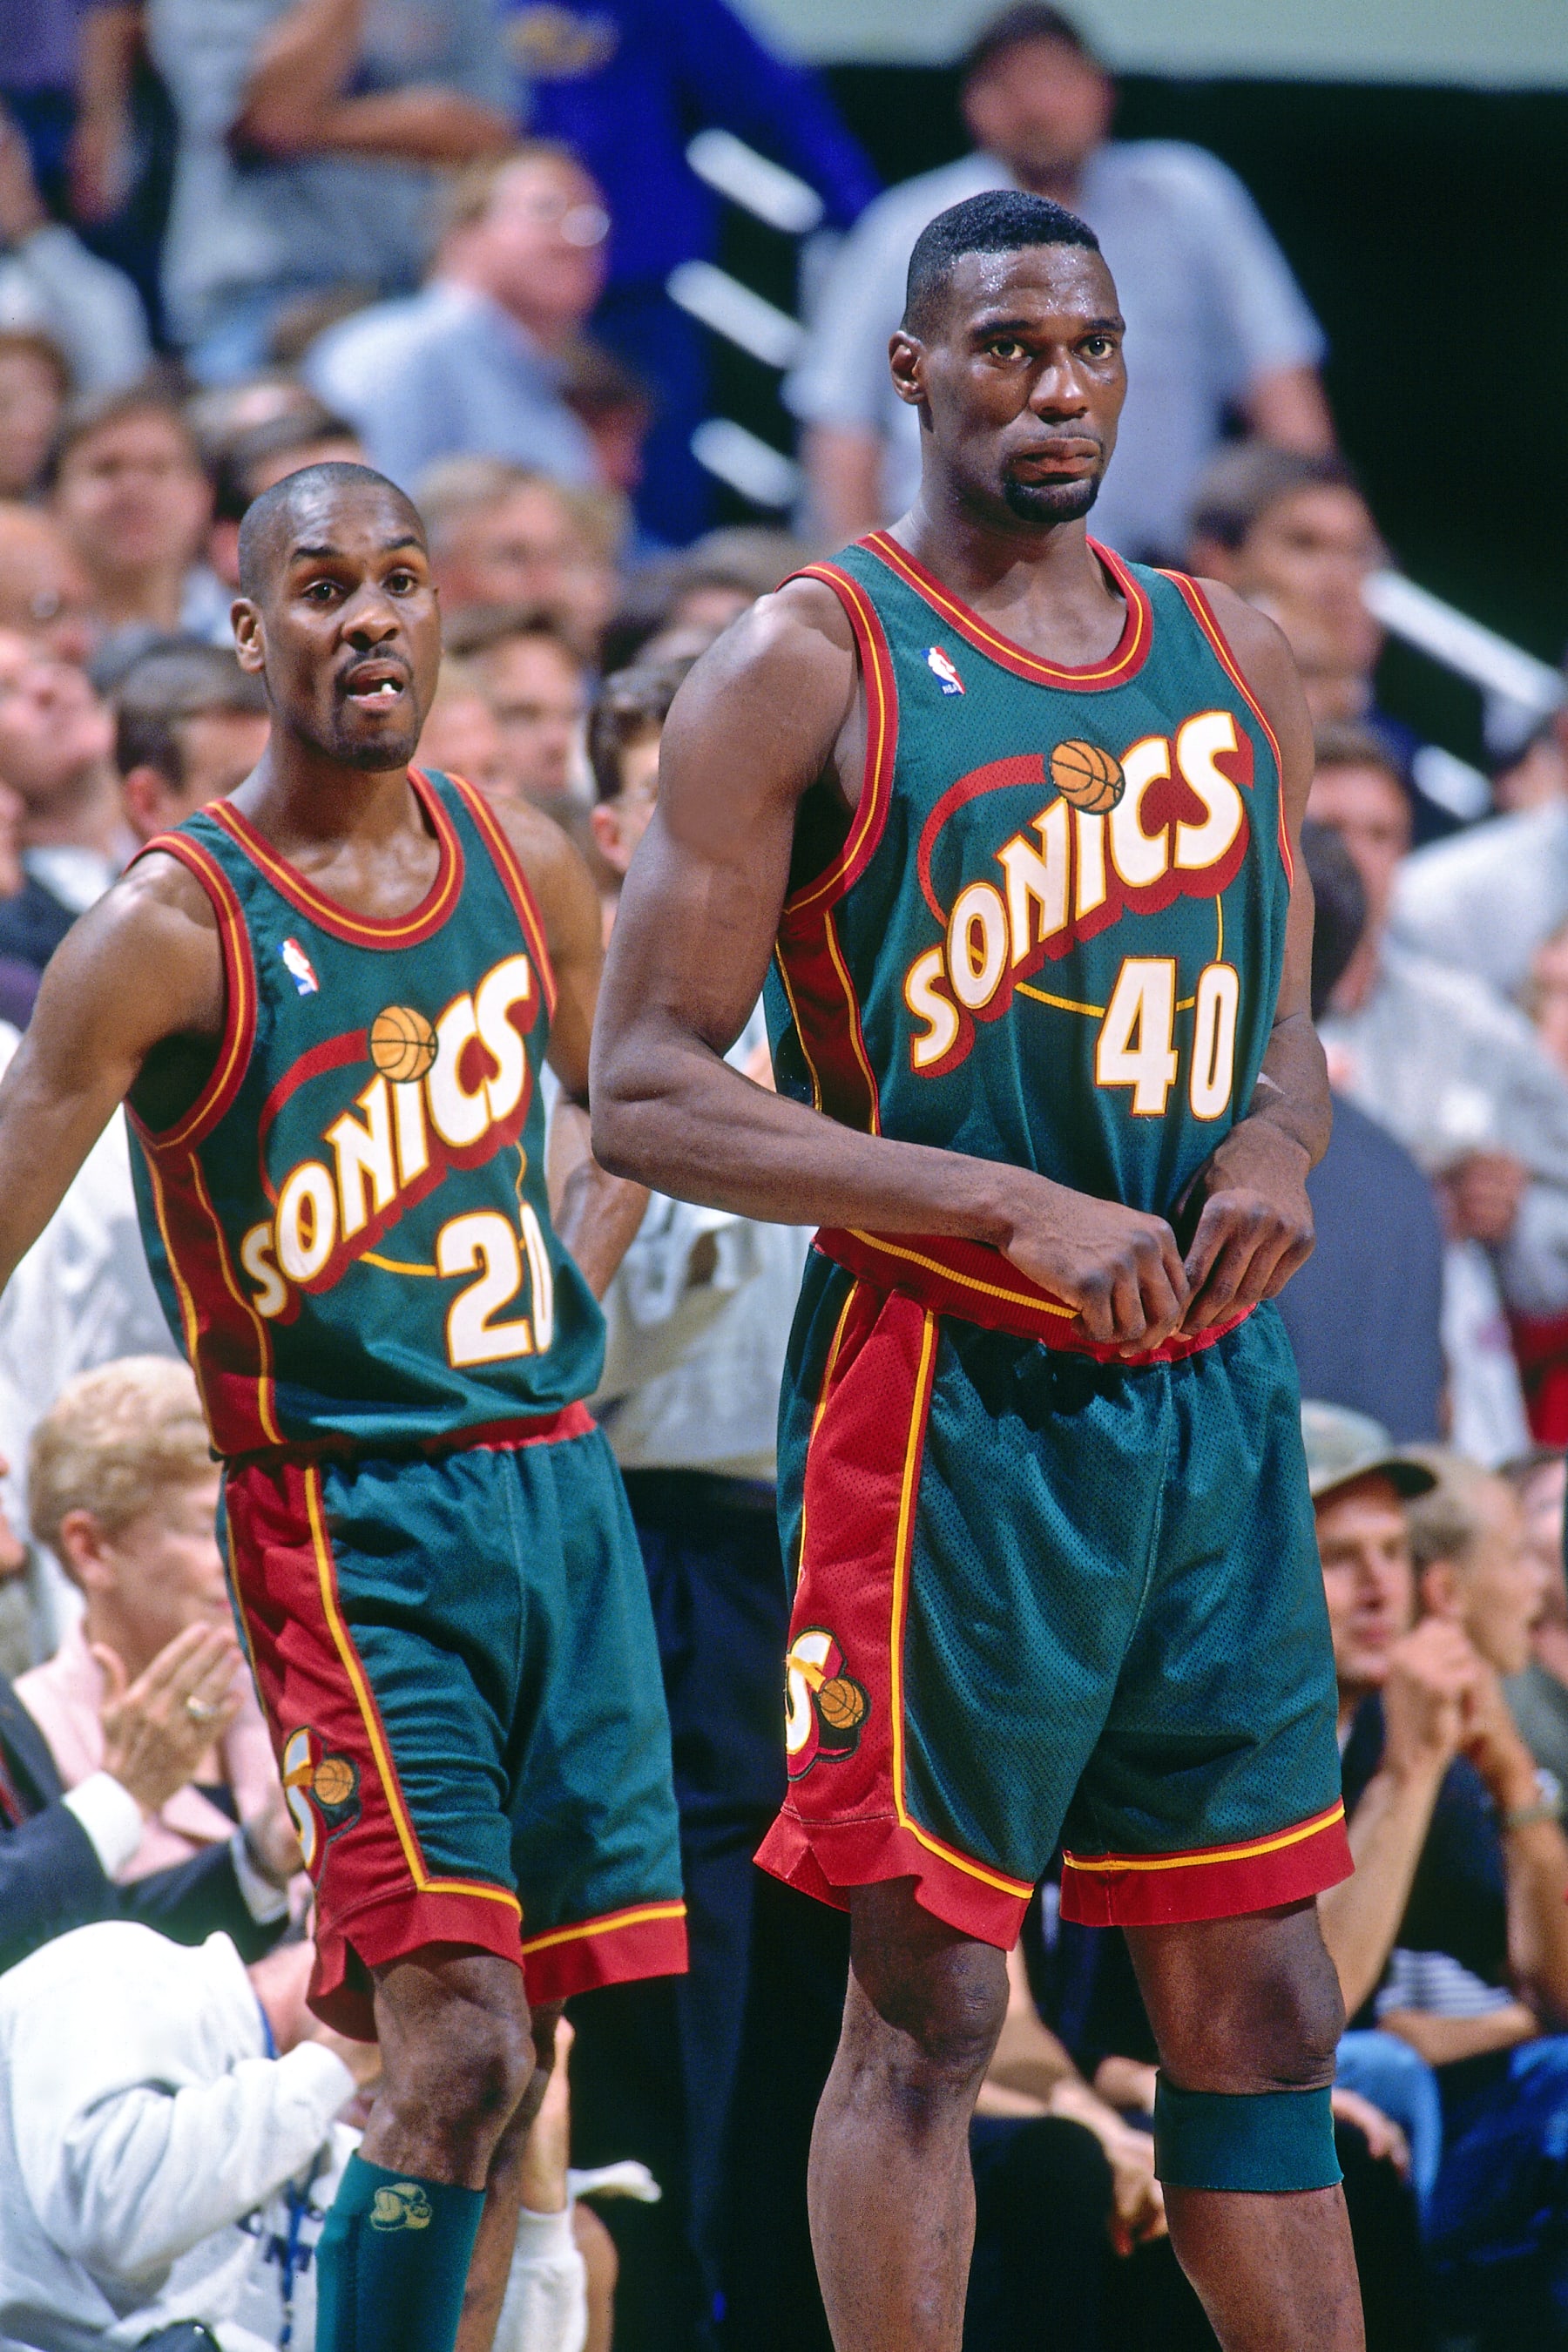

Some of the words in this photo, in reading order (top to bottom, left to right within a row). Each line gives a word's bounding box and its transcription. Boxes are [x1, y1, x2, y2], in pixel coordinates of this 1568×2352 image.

[903, 709, 1247, 1071] SONICS
[240, 953, 531, 1319] SONICS
[1095, 956, 1240, 1121] 40
[436, 1201, 554, 1368] 20
